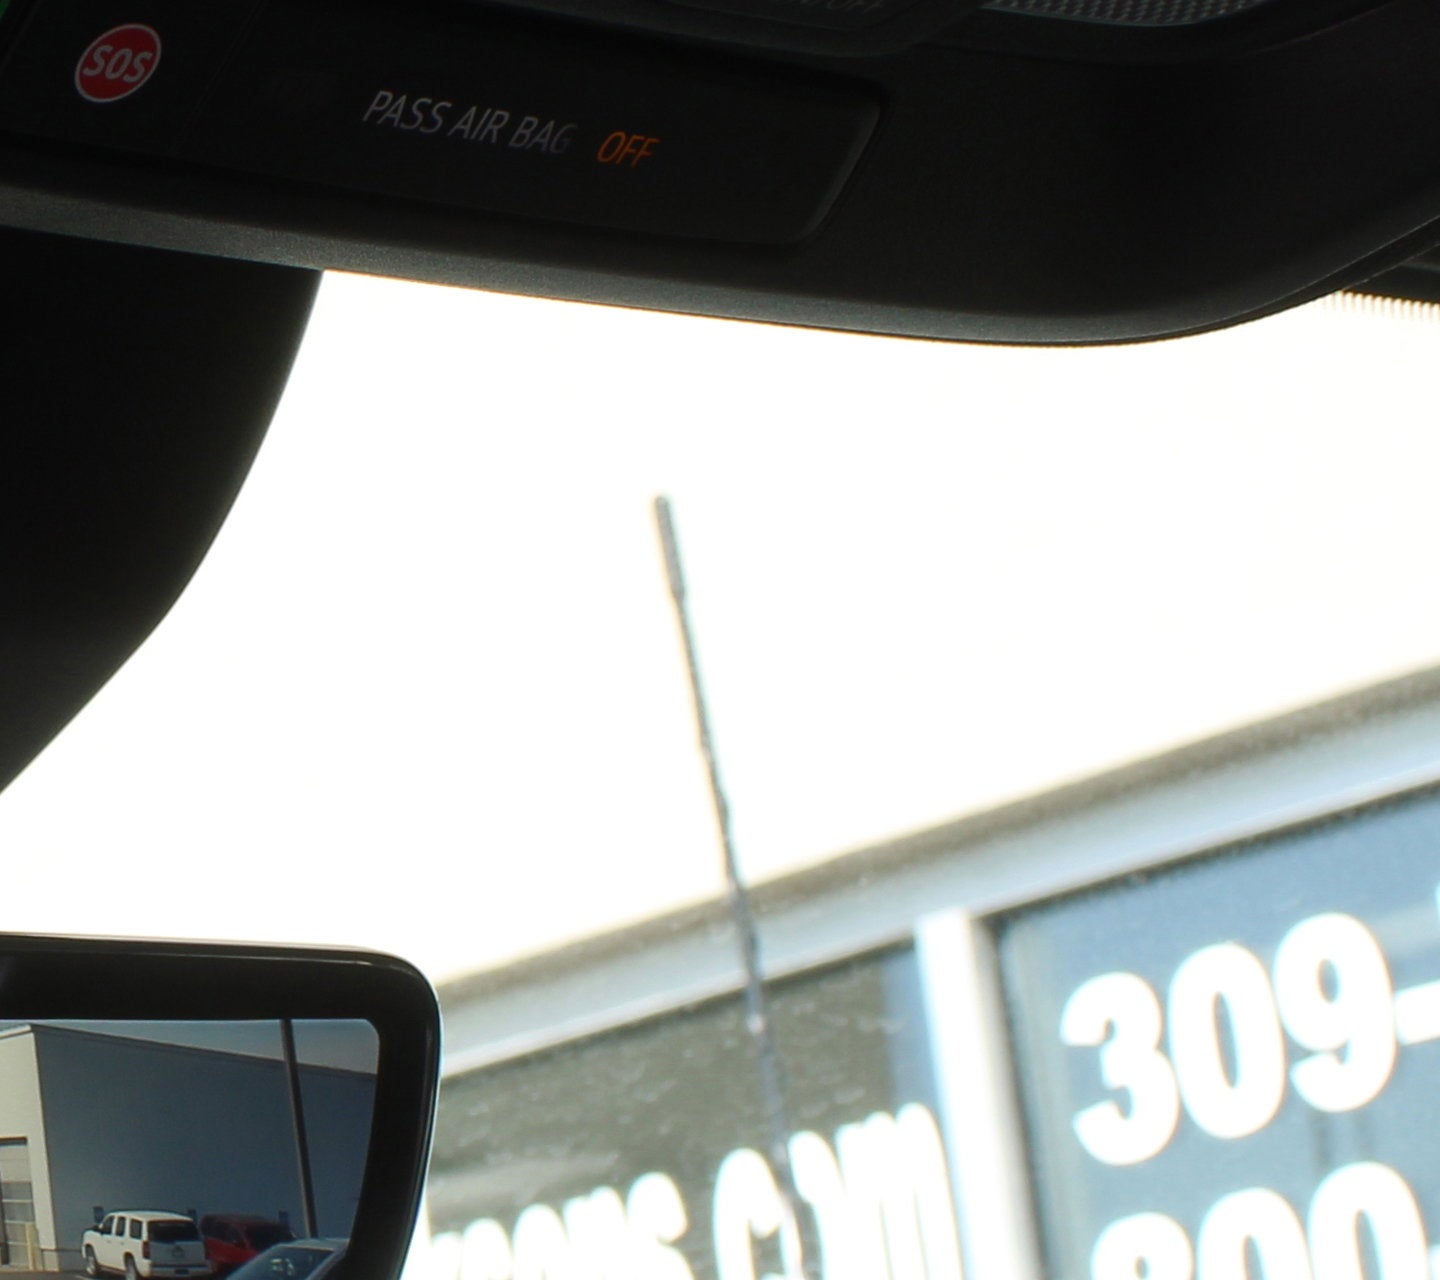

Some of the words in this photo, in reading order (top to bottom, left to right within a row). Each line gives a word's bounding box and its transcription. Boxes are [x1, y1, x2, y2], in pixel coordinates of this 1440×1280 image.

[83, 44, 153, 83] SOS
[362, 90, 452, 134] PASS
[448, 105, 511, 140] AIR
[509, 116, 578, 154] BAG
[595, 131, 661, 168] OFF
